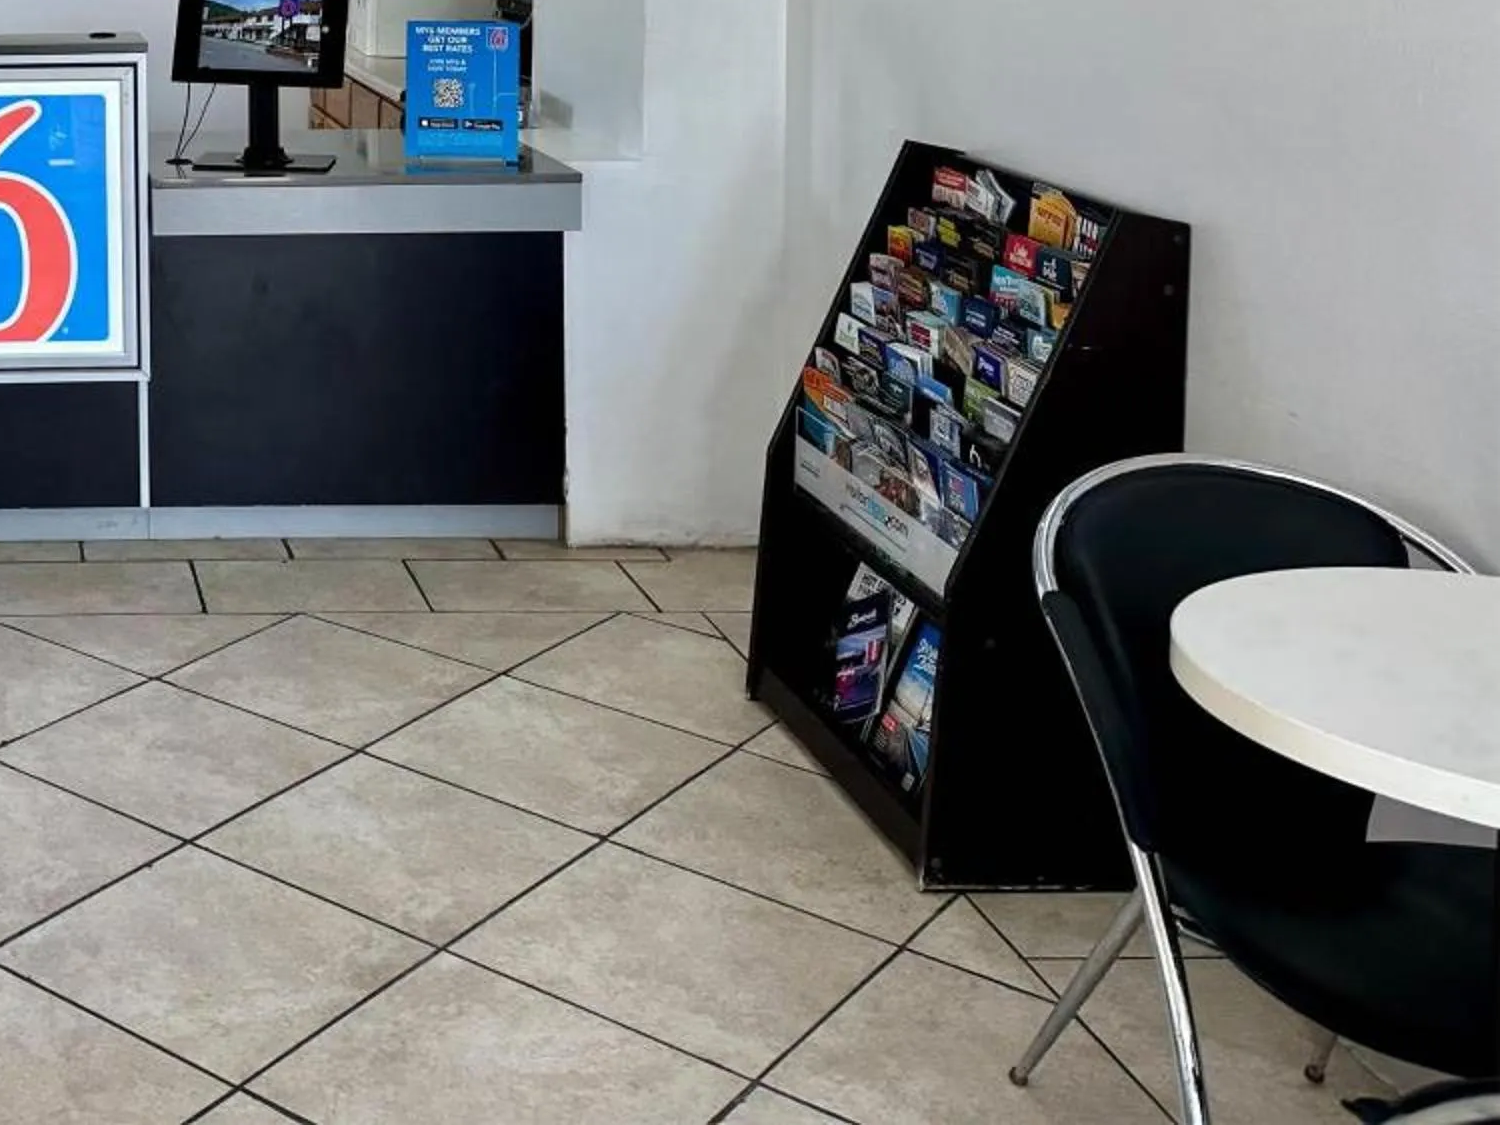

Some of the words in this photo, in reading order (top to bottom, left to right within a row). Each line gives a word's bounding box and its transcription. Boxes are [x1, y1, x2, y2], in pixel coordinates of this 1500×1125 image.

[437, 26, 481, 36] MEMBERS
[447, 36, 468, 44] OUR
[445, 44, 473, 54] RATES
